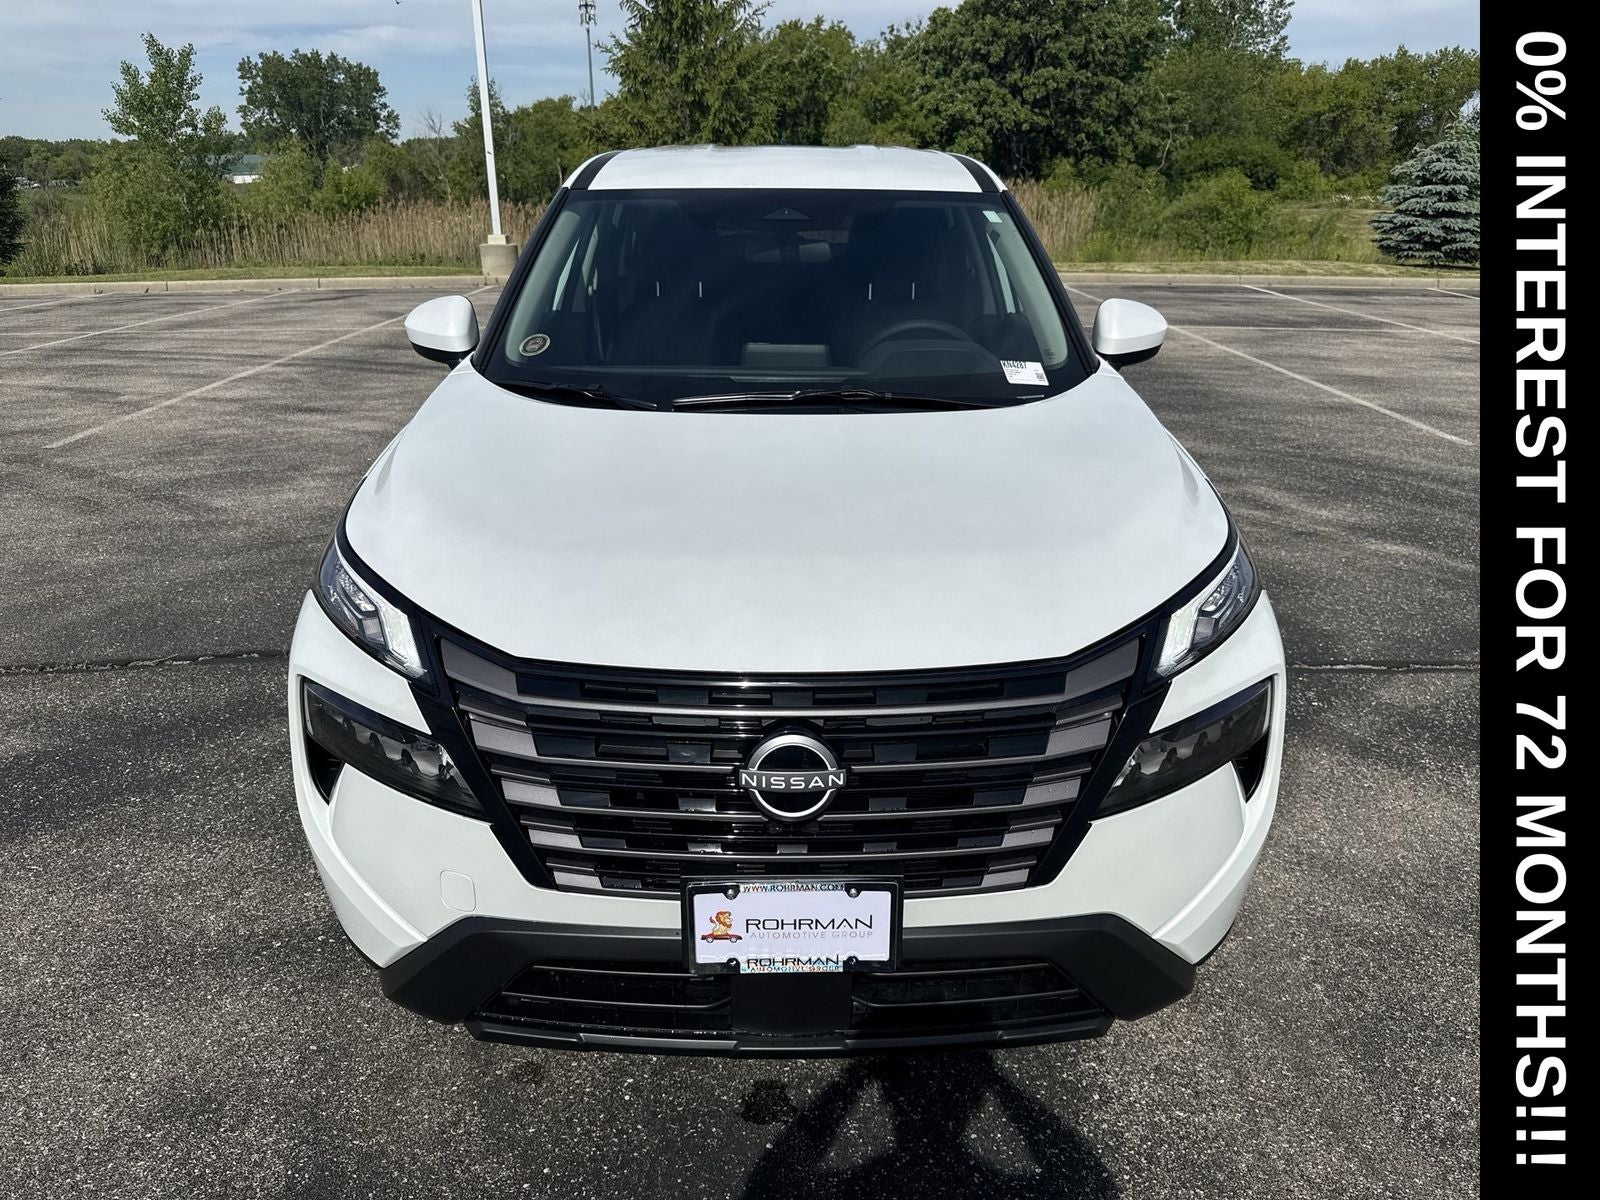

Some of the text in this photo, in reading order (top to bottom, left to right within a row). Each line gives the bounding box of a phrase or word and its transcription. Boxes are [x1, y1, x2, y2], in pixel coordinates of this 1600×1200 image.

[741, 773, 844, 789] NISSAN
[743, 883, 844, 892] WWW.ROHRMAN.COM
[745, 914, 873, 933] ROHRMAN
[750, 931, 825, 939] AUTOMOTIVE
[747, 955, 839, 969] ROHRMAN
